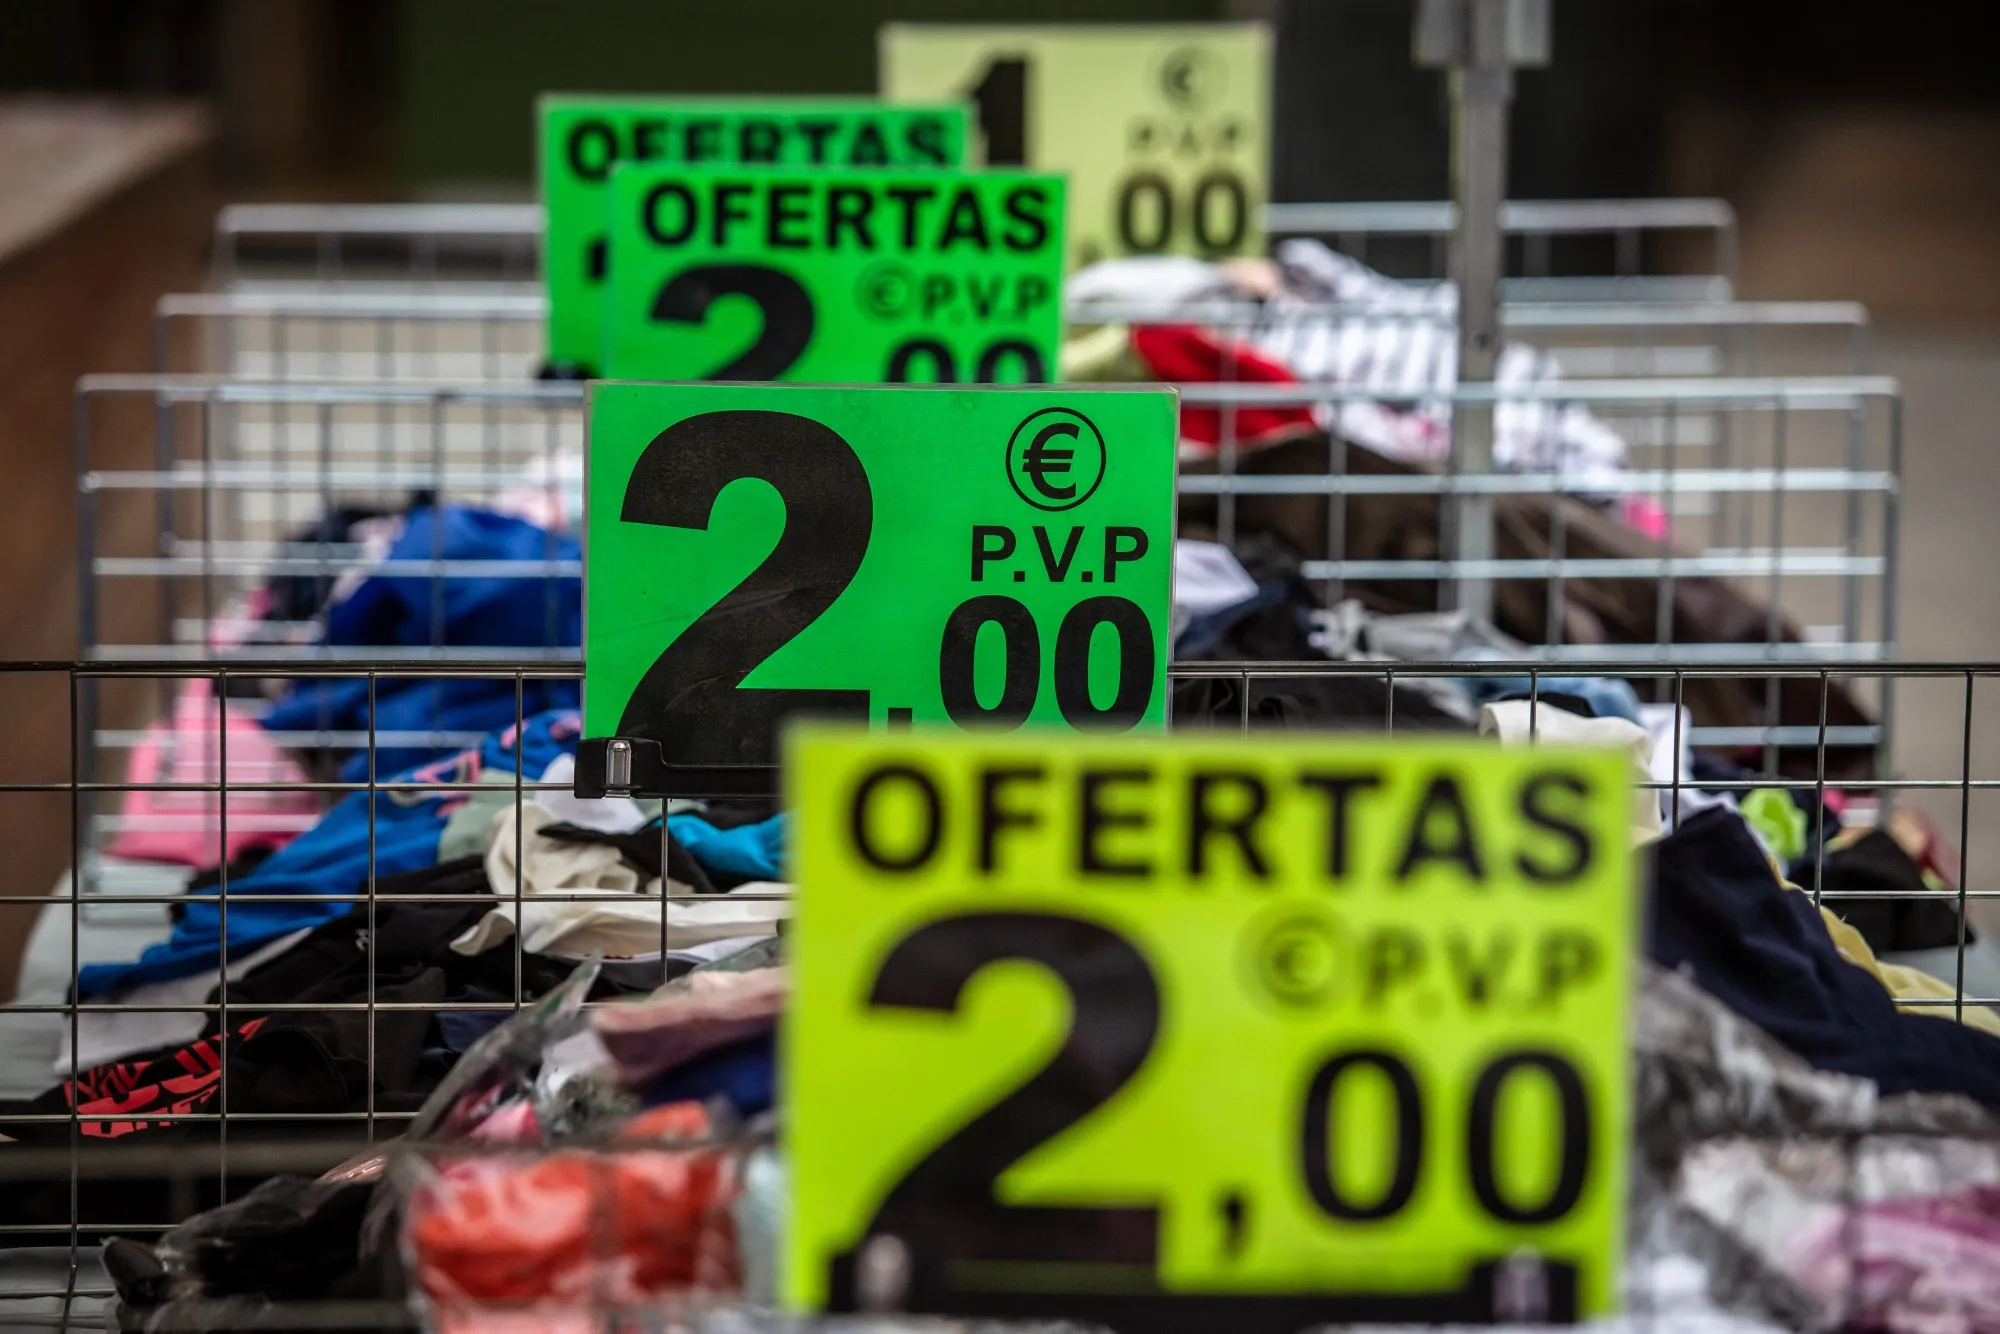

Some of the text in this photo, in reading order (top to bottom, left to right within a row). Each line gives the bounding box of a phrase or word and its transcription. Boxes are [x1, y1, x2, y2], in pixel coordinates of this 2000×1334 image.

[640, 182, 1050, 252] OFERTAS
[970, 525, 1150, 583] P.V.P
[844, 760, 1600, 886] OFERTAS
